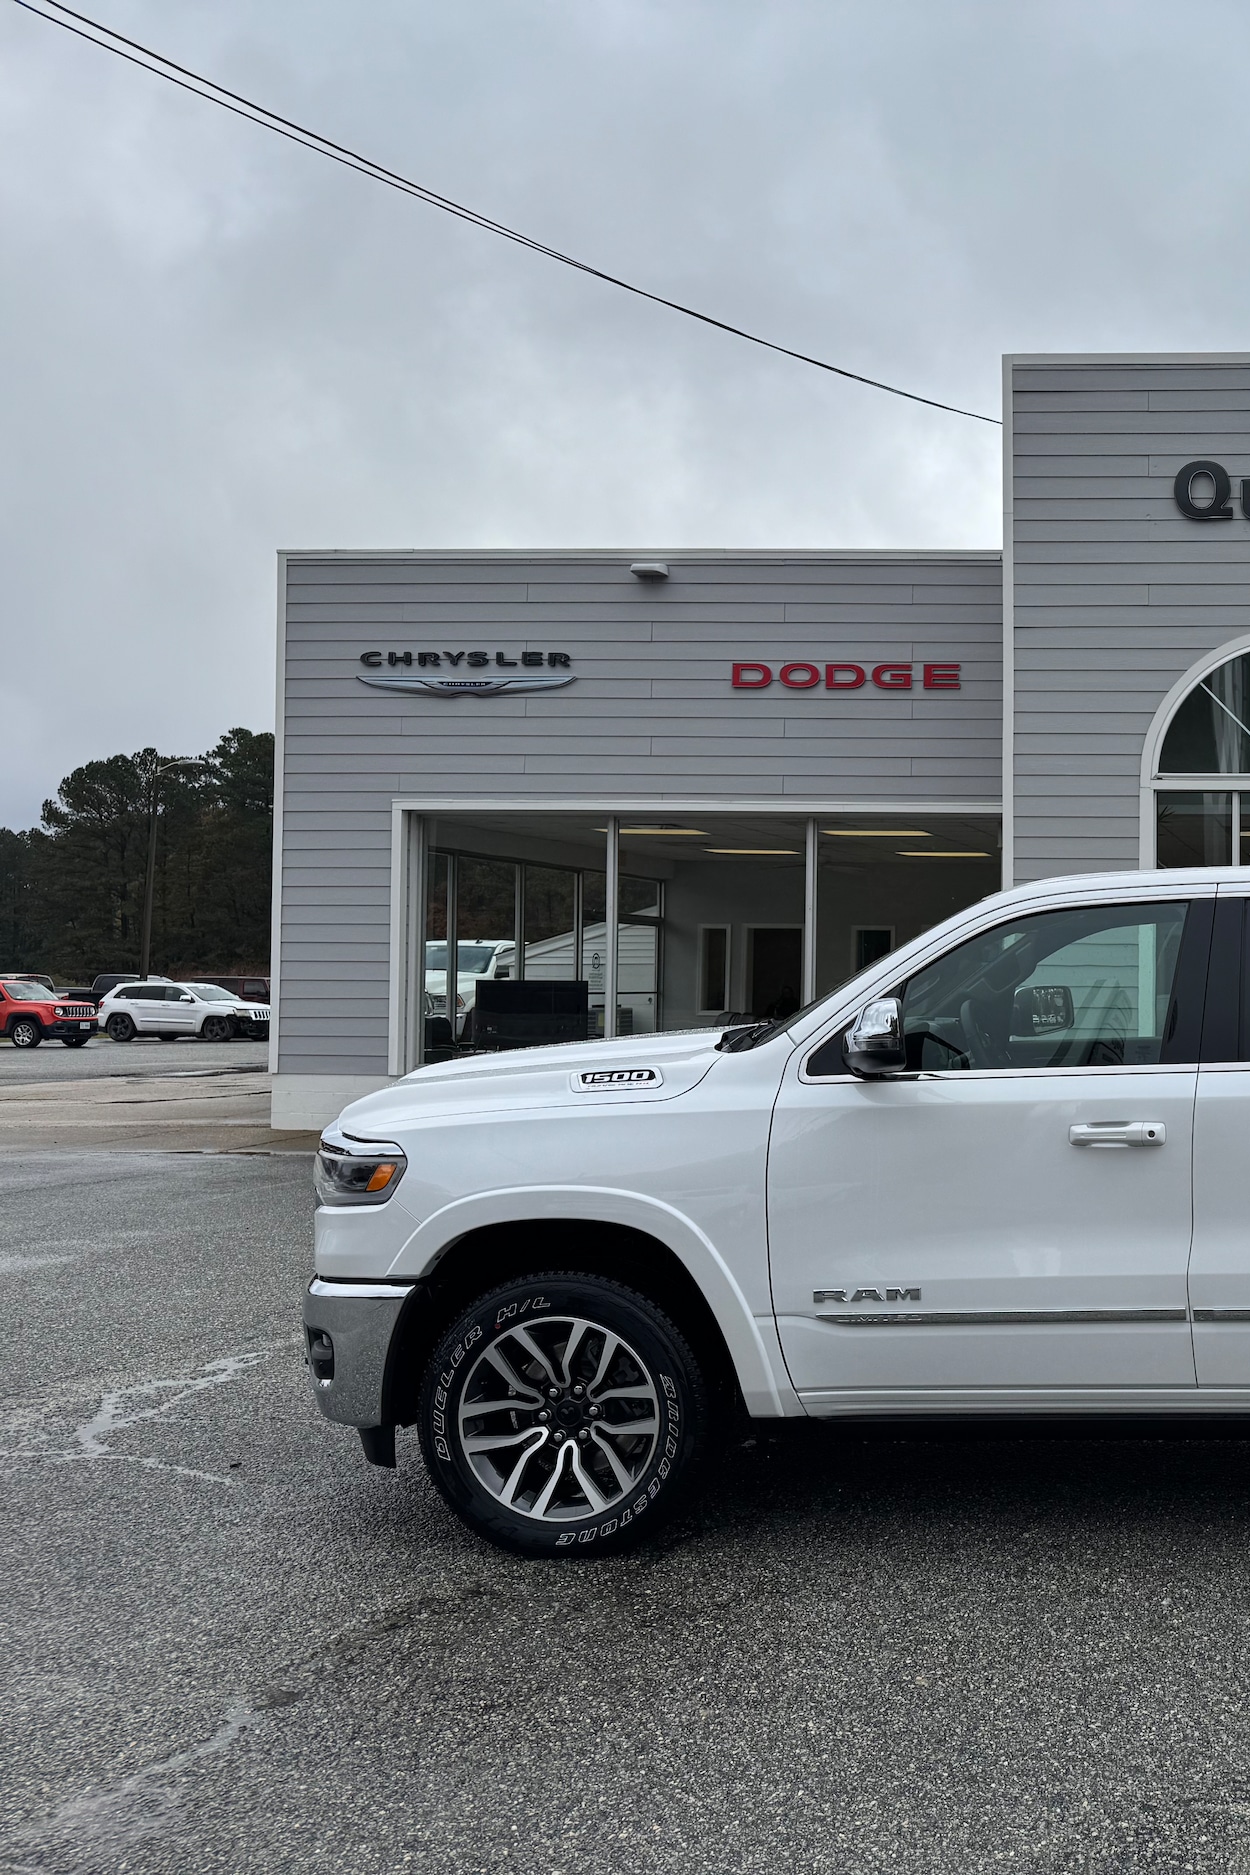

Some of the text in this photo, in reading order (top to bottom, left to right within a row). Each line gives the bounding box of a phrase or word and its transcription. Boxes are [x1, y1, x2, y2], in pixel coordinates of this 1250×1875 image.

[360, 651, 571, 667] CHRYSLER
[732, 663, 961, 689] DODGE
[585, 1071, 650, 1083] 1500
[813, 1287, 921, 1303] RAM
[432, 1296, 552, 1462] DUELER H/L
[555, 1373, 680, 1546] BRIDGESTONE
